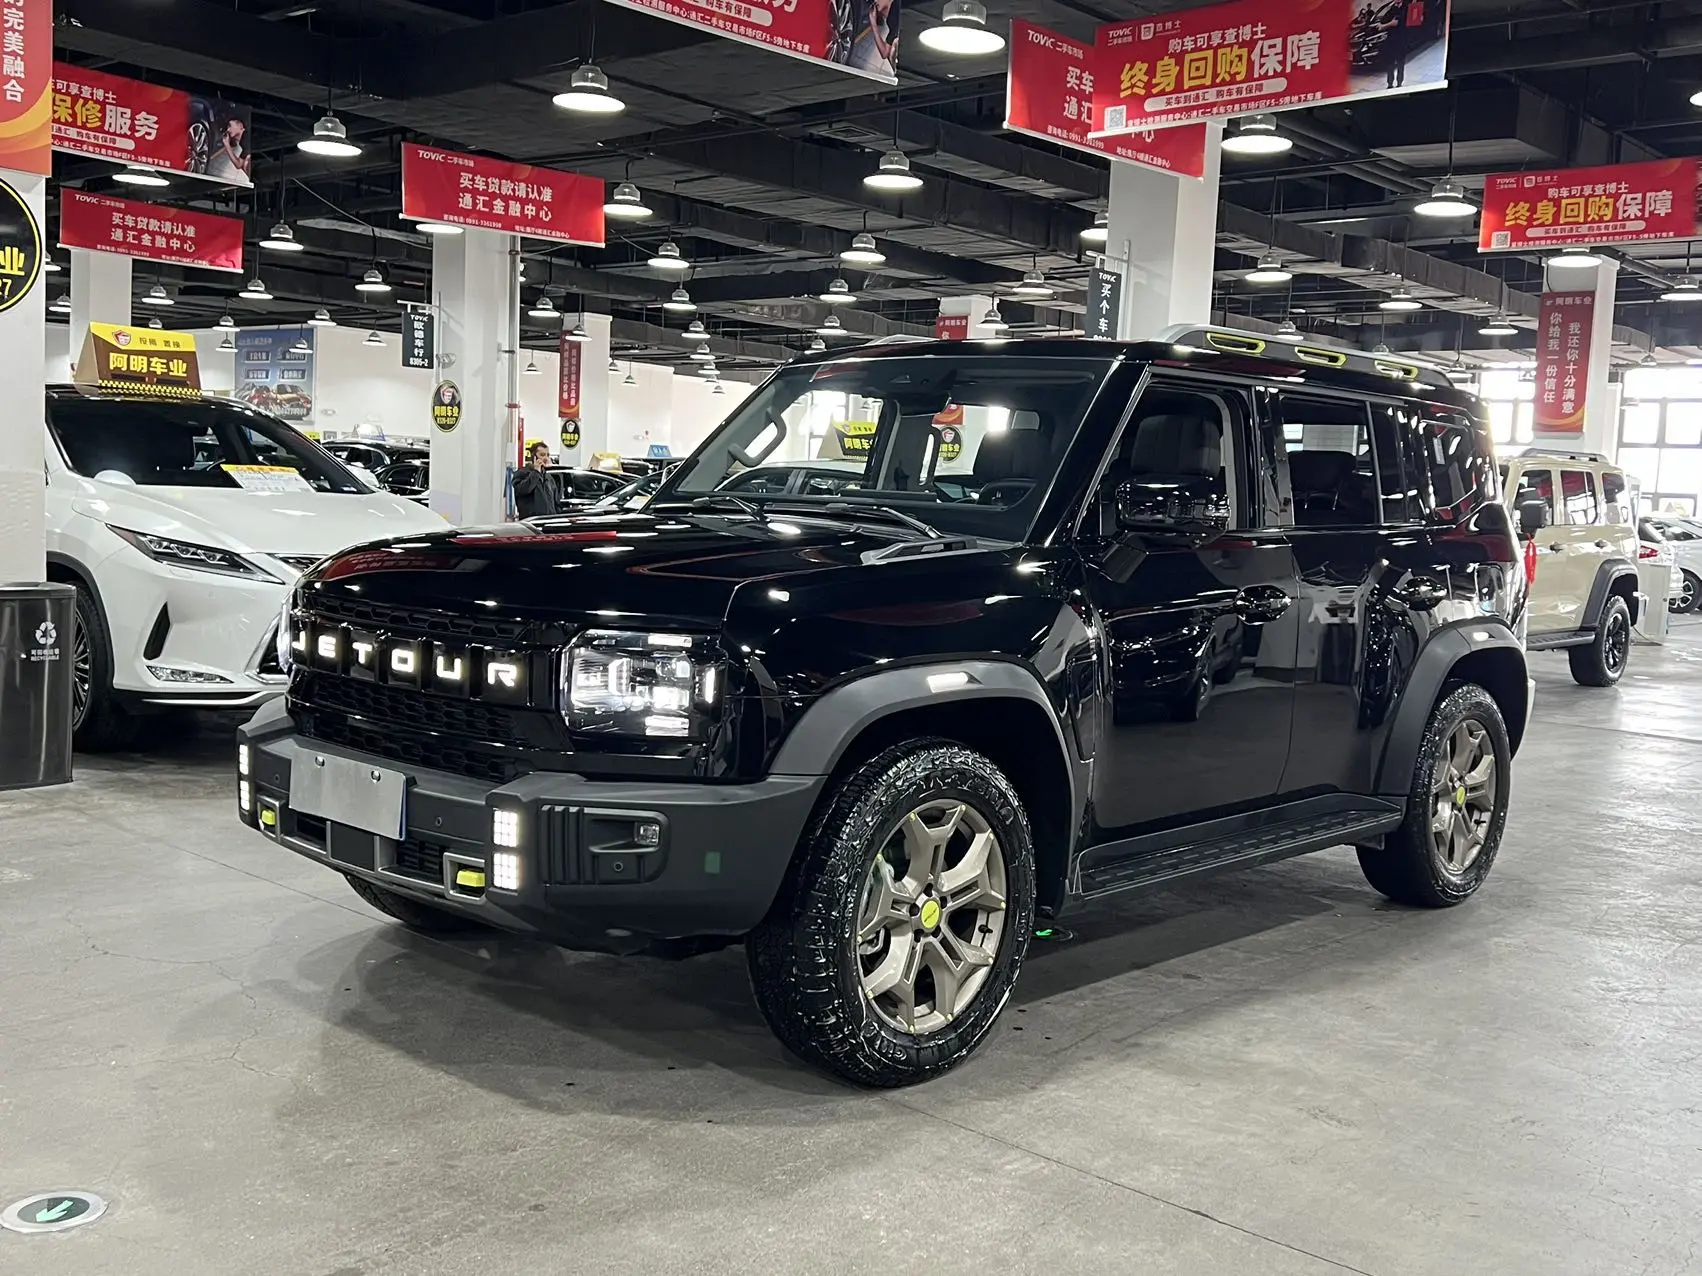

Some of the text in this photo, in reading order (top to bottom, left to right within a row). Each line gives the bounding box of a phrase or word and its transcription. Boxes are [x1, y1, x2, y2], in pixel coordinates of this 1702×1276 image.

[1168, 23, 1267, 54] 购车可享查博士
[1120, 31, 1321, 98] 终身回购保障
[459, 172, 553, 202] 买车贷款请认准
[1548, 182, 1629, 199] 购车可享查博士
[458, 192, 552, 222] 通汇金融中心
[1504, 189, 1673, 227] 终身回购保障
[111, 212, 196, 238] 买车贷款请认准
[110, 228, 196, 253] 通汇金融中心
[109, 352, 188, 377] 阿明车业
[1543, 312, 1562, 403] 你给我一份信任
[1562, 322, 1581, 413] 我还你十分满意
[843, 437, 873, 450] 阿明车
[292, 630, 517, 687] JETOUR
